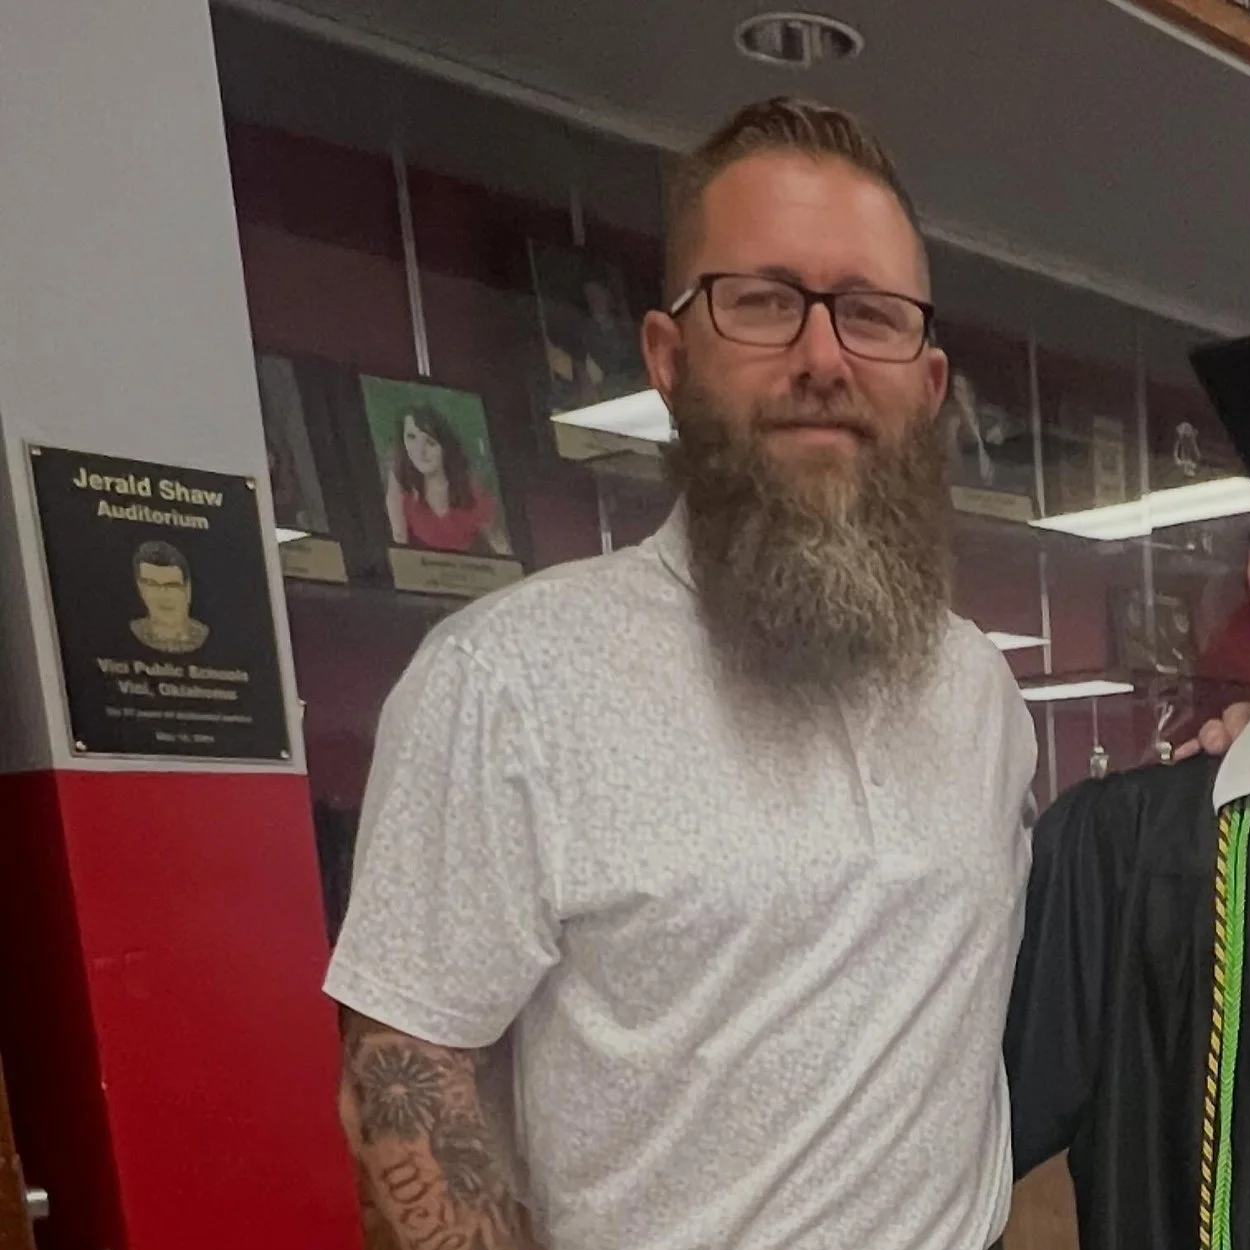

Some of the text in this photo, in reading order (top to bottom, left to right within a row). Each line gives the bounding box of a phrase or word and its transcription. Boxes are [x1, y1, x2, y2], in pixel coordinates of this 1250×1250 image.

[73, 466, 223, 507] Jerald Shaw
[97, 499, 209, 529] Auditorium
[133, 660, 184, 678] Public
